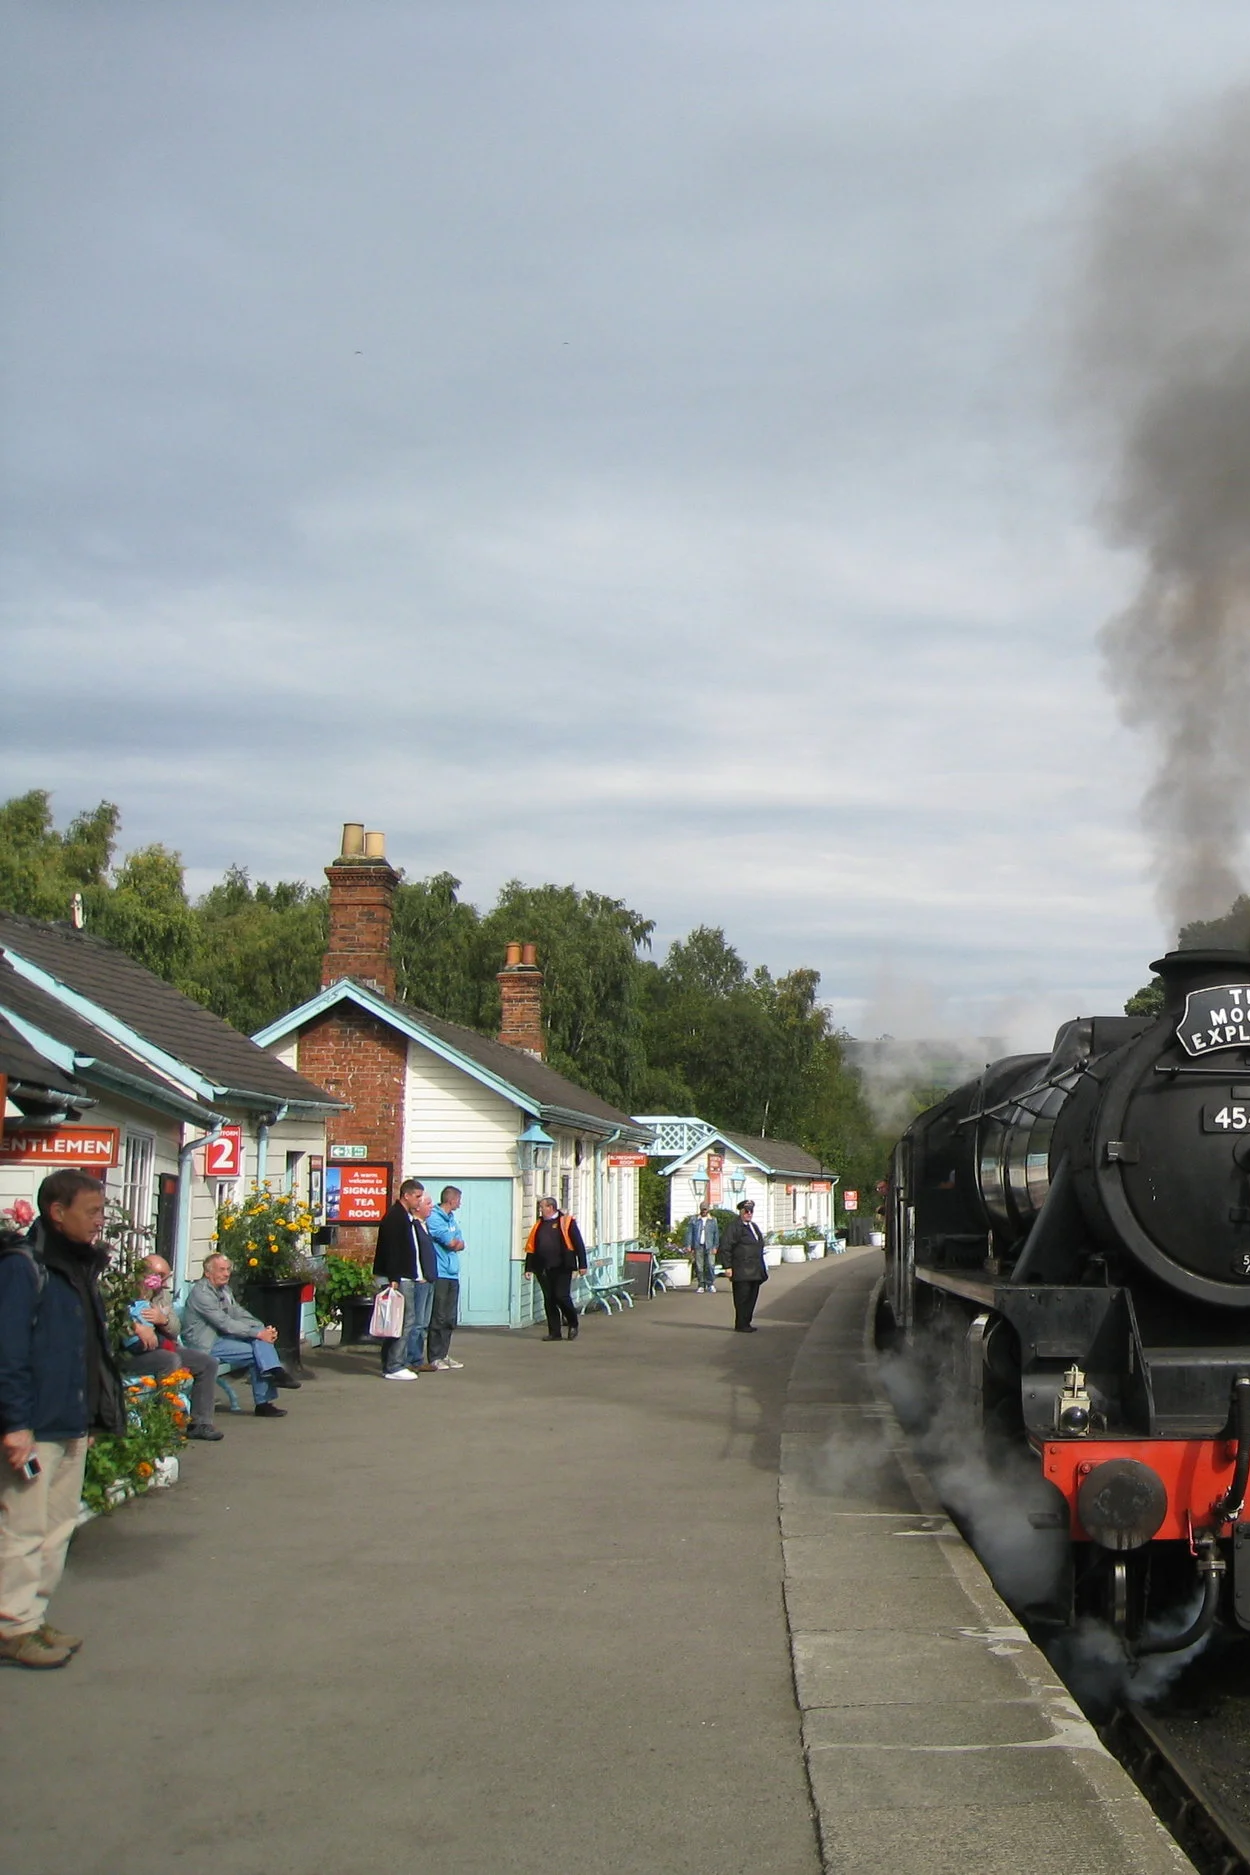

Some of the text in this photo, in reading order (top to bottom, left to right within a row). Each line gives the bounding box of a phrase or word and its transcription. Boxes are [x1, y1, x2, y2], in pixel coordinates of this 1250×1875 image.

[0, 1138, 111, 1154] ENTLEMEN
[212, 1138, 233, 1168] 2
[343, 1187, 388, 1195] SIGNALS
[354, 1198, 375, 1207] TEA
[348, 1210, 380, 1218] ROOM
